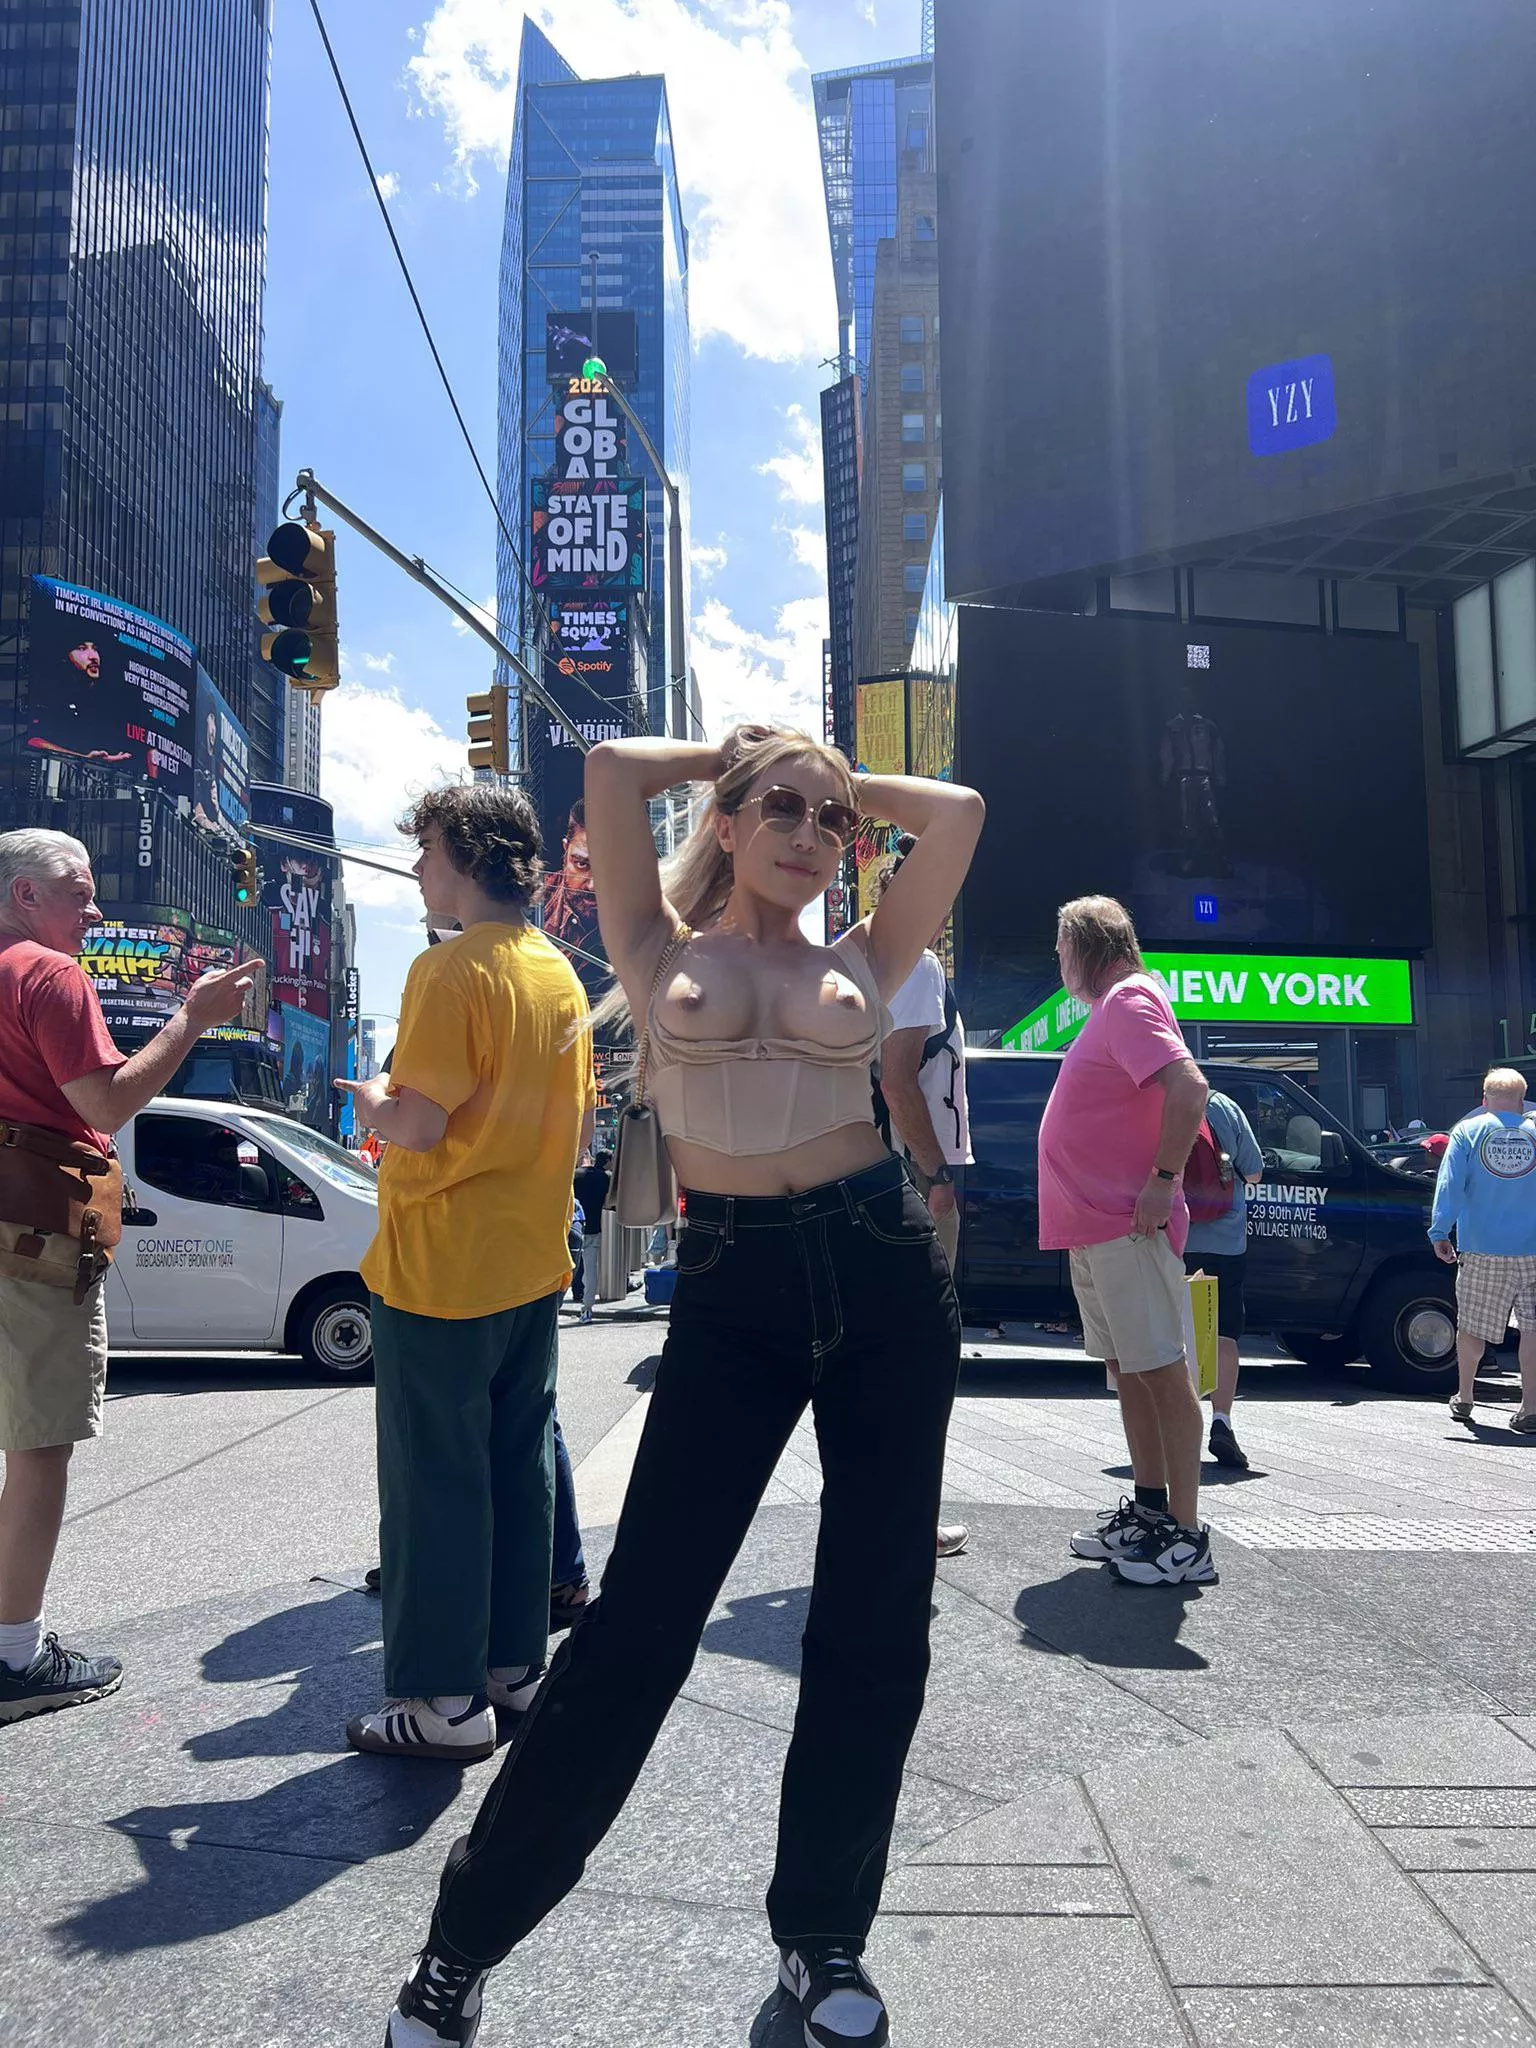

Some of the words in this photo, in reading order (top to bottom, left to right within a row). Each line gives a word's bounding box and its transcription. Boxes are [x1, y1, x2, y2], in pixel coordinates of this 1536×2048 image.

[1268, 378, 1314, 427] YZY
[547, 495, 628, 546] STATE
[547, 517, 592, 545] OF
[547, 530, 628, 572] MIND
[55, 586, 89, 606] TIMCAST
[104, 601, 124, 618] MADE
[55, 599, 64, 611] IN
[66, 602, 79, 615] MY
[80, 606, 126, 632] CONVICTIONS
[560, 611, 617, 625] TIMES
[577, 661, 613, 672] Spotify
[126, 722, 146, 743] LIVE
[146, 730, 157, 748] AT
[168, 759, 180, 776] EST
[139, 803, 152, 867] 1500
[280, 883, 319, 928] SAY
[102, 920, 124, 929] THE
[289, 927, 311, 970] HI
[346, 969, 358, 1005] Locker
[1152, 969, 1249, 1005] NEW
[1258, 971, 1371, 1007] YORK
[115, 1016, 129, 1025] ON
[617, 1053, 633, 1061] ONE
[1488, 1146, 1506, 1155] LONG
[1508, 1147, 1532, 1156] BEACH
[1244, 1183, 1328, 1205] DELIVERY
[1268, 1206, 1292, 1220] 90th
[1294, 1207, 1317, 1222] AVE
[1255, 1222, 1289, 1238] VILLAGE
[1290, 1224, 1303, 1238] NY
[1304, 1225, 1328, 1240] 11428
